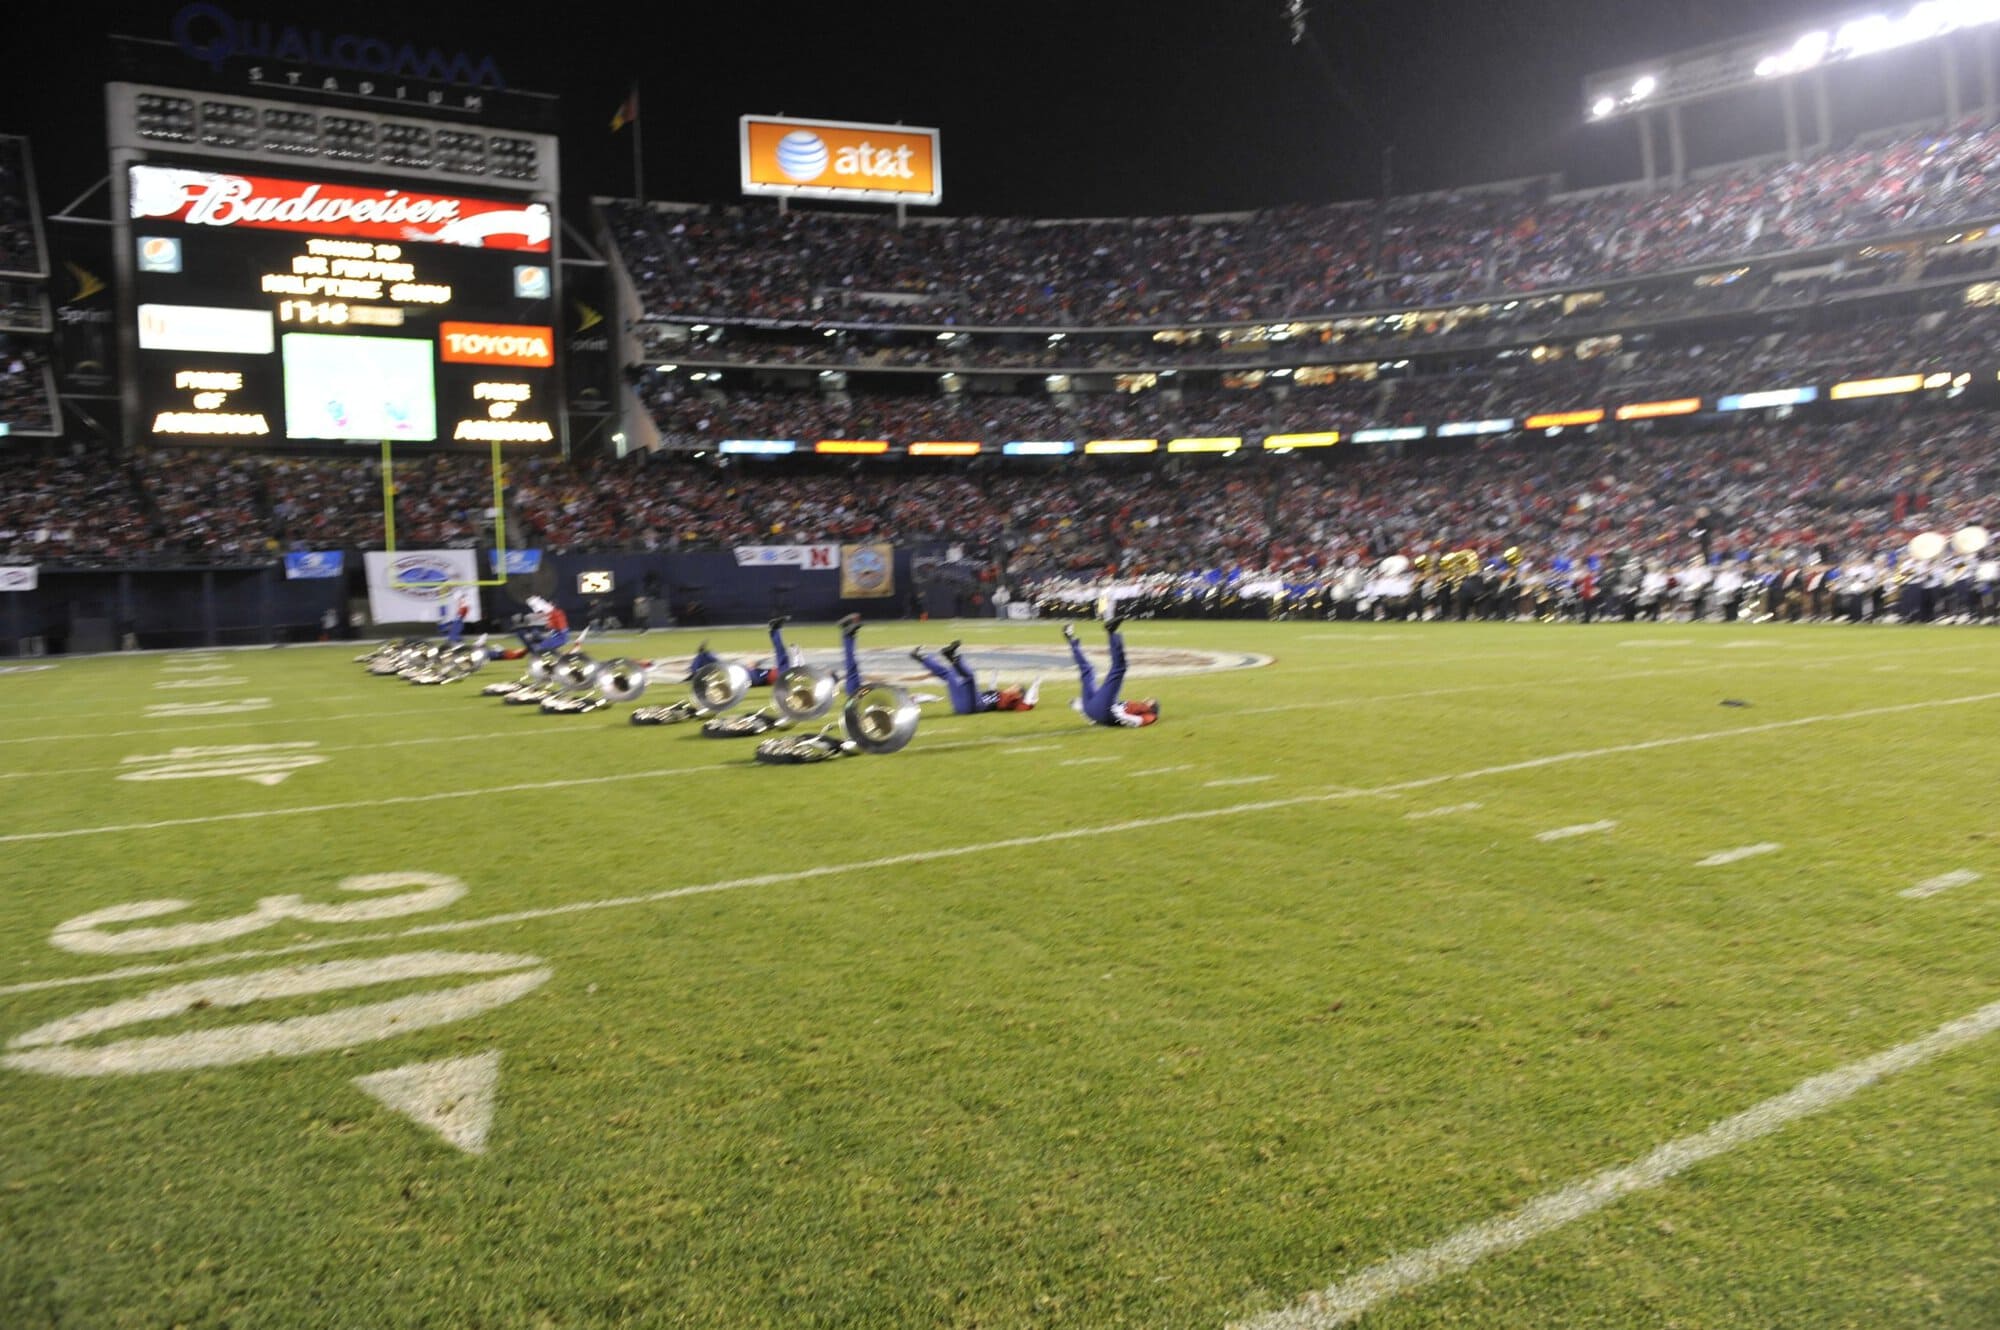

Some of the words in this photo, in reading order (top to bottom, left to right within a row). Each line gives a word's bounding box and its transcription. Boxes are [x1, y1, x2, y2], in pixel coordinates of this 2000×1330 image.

[172, 1, 505, 92] QUALCOMM
[248, 66, 483, 111] STADIUM
[834, 140, 915, 180] at&t
[179, 173, 462, 227] Budweiser
[446, 333, 549, 358] TOYOTA
